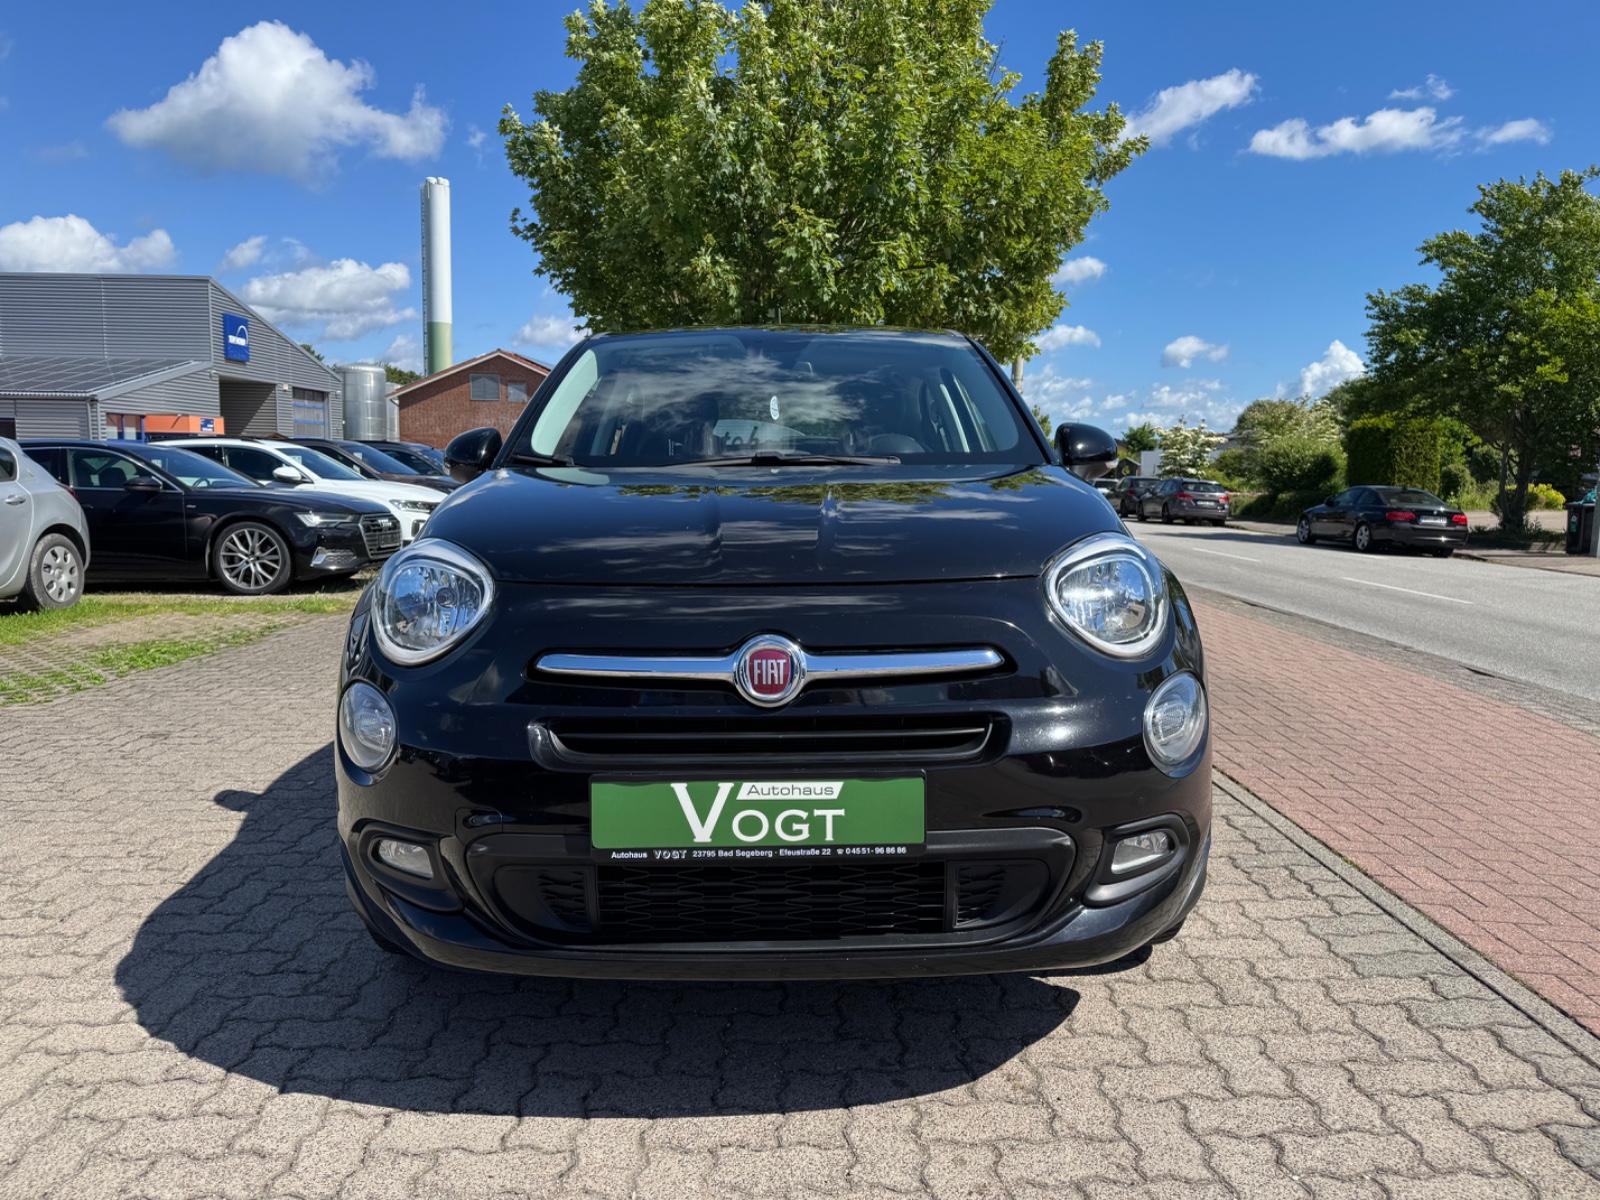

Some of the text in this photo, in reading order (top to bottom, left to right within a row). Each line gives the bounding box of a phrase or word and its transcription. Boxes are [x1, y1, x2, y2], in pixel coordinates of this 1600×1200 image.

[754, 659, 786, 685] FIAT
[747, 784, 834, 796] Autohaus
[670, 782, 845, 843] VOGT
[611, 851, 648, 859] Autohaus
[653, 849, 687, 859] VOGT
[692, 849, 716, 858] 23795
[718, 849, 733, 858] Bad
[735, 849, 773, 858] Segeberg
[821, 848, 832, 856] 22
